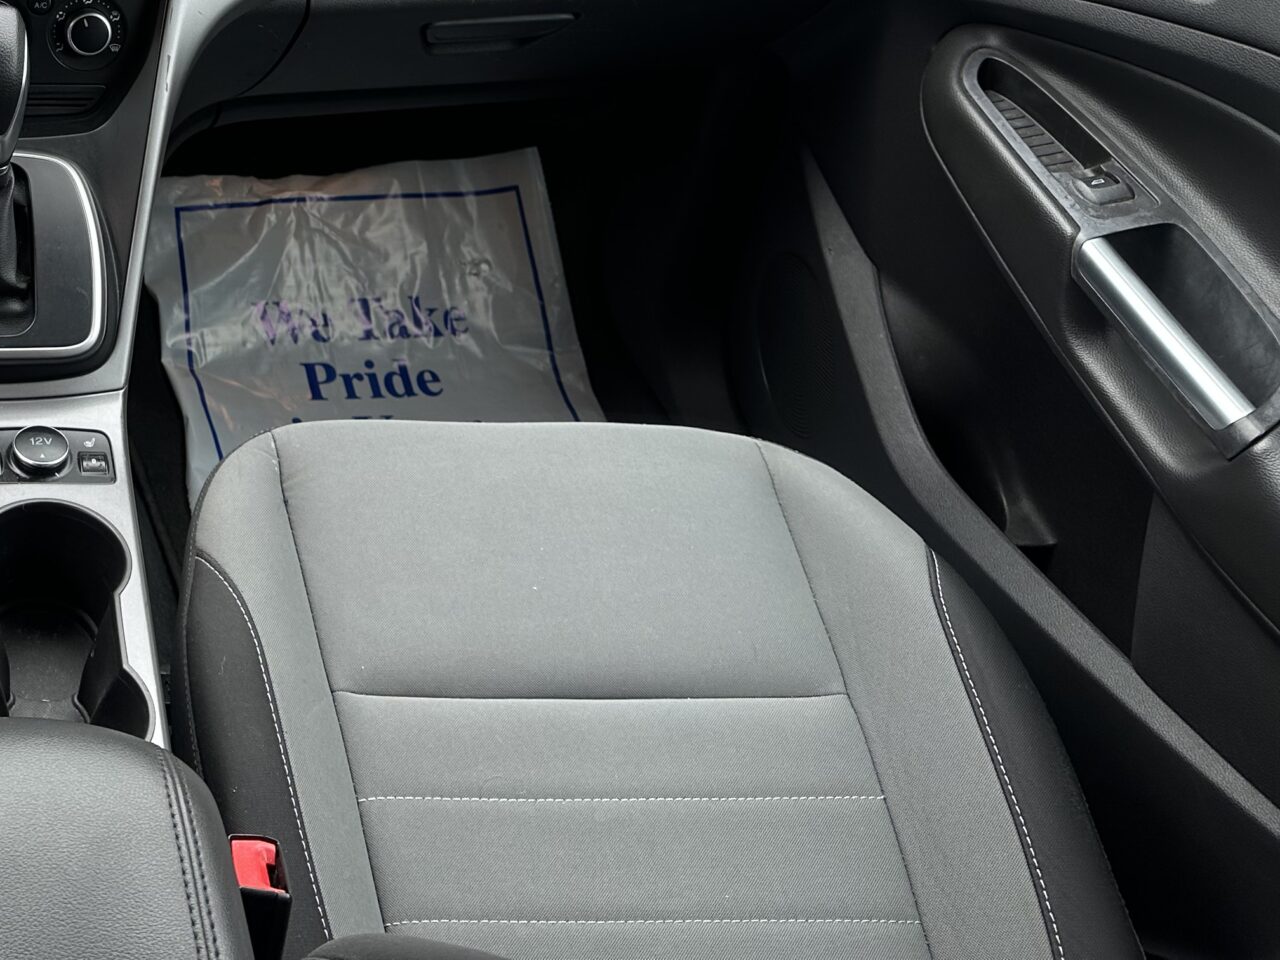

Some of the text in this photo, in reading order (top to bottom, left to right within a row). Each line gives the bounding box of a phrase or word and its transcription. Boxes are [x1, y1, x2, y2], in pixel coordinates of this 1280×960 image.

[33, 1, 48, 9] A/C
[350, 295, 469, 341] Take
[299, 359, 445, 401] Pride
[29, 437, 53, 446] 12V
